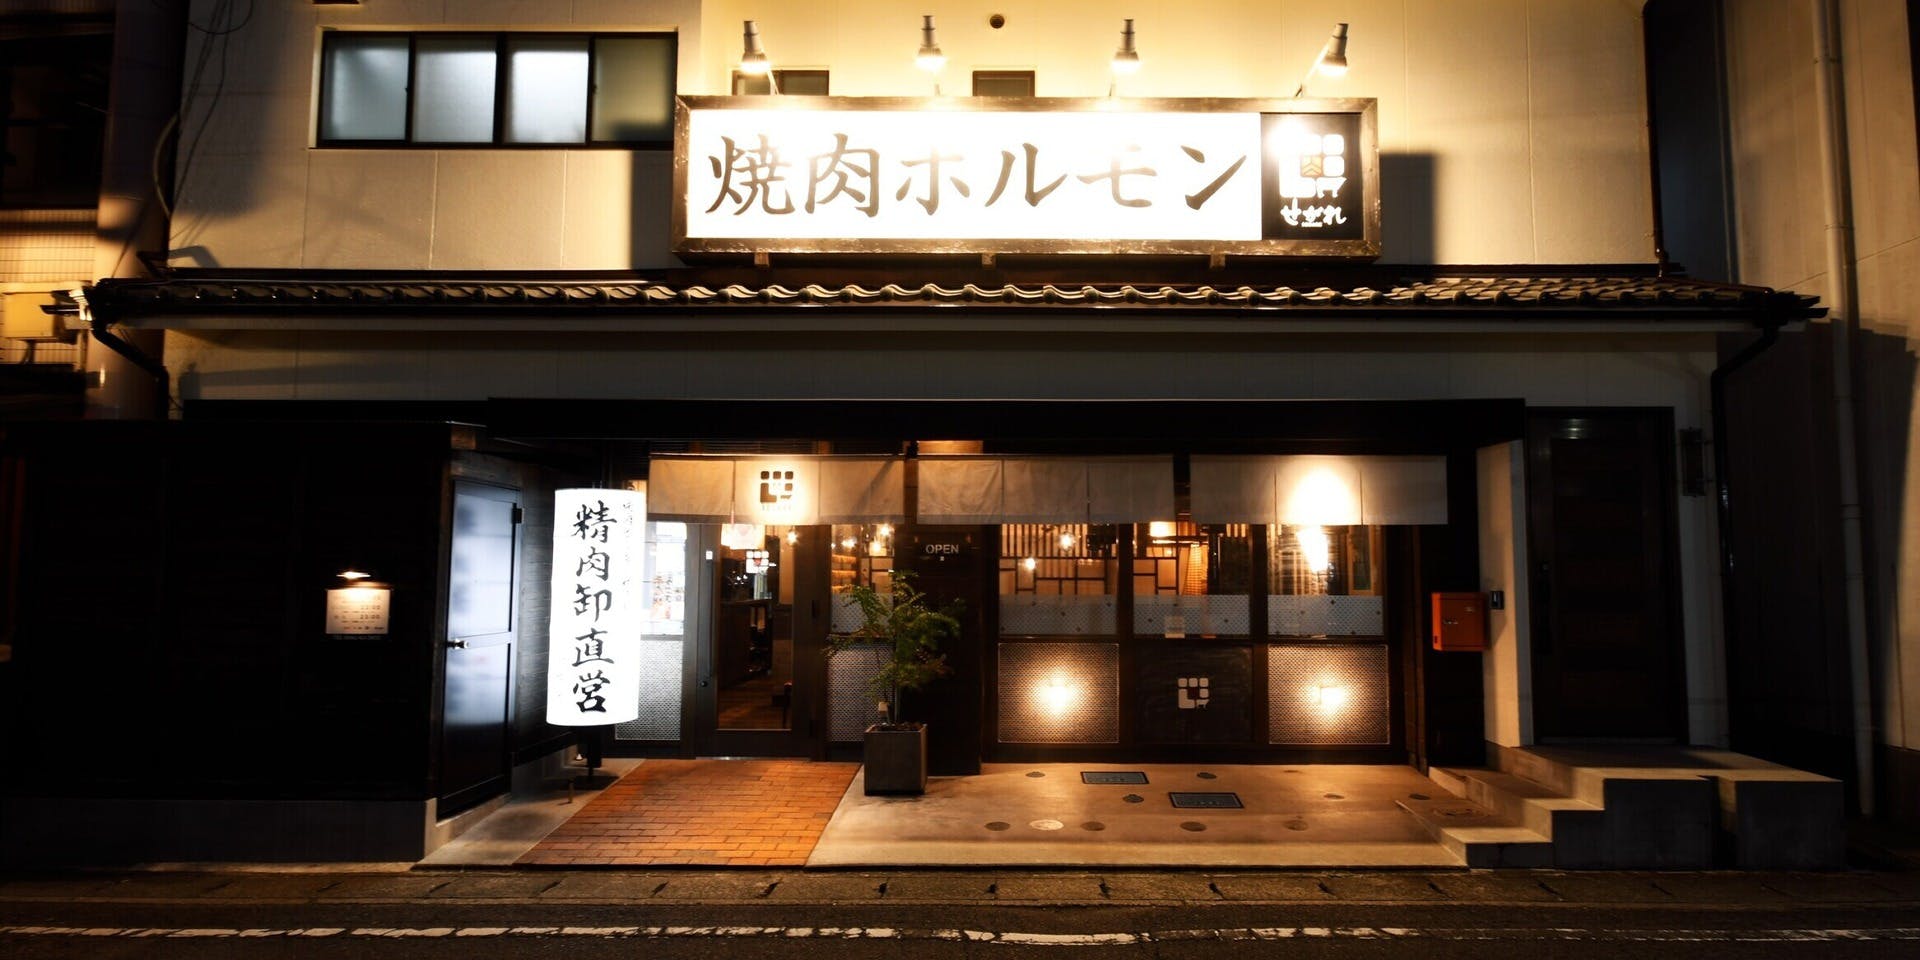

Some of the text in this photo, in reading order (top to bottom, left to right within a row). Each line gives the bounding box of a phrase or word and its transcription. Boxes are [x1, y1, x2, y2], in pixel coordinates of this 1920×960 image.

[705, 131, 1247, 218] 焼肉ホルモン
[1280, 197, 1347, 226] せがれ
[925, 544, 959, 554] OPEN
[571, 500, 618, 714] 精肉卸直営
